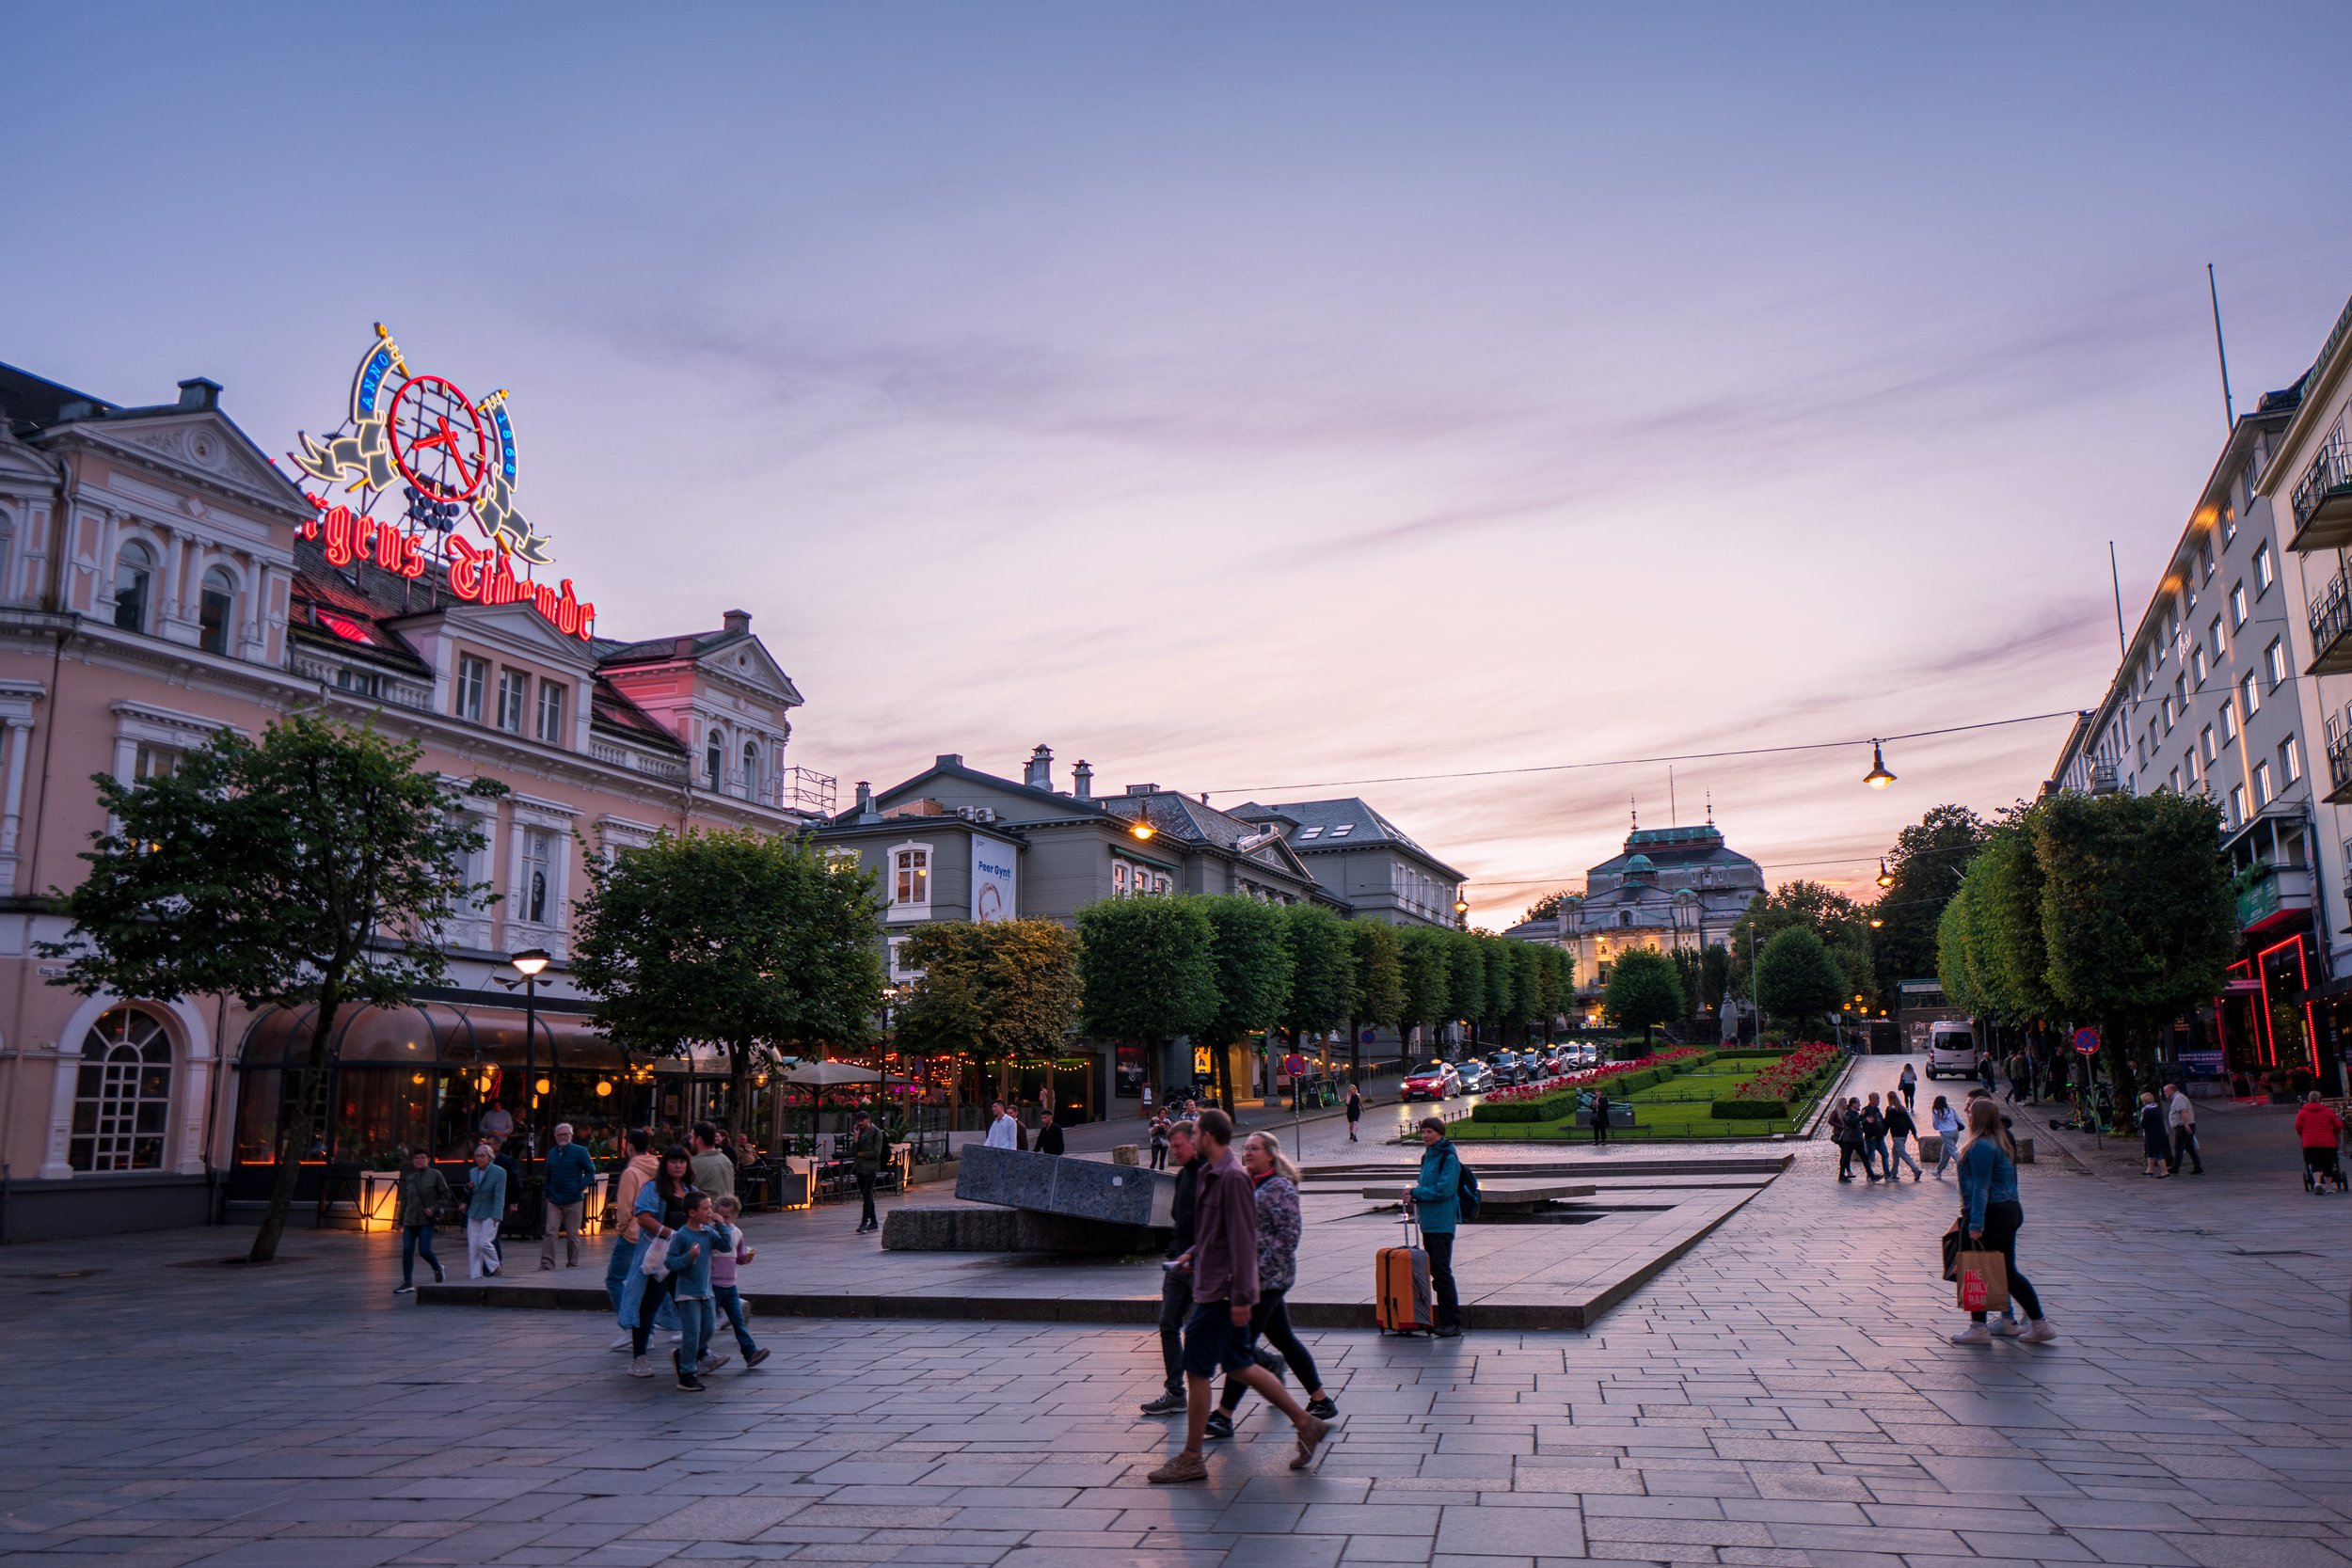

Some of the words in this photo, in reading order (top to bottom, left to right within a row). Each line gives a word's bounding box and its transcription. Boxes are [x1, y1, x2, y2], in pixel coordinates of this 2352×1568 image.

[361, 351, 390, 411] ANNO
[496, 413, 516, 475] 1868
[978, 860, 993, 874] Peer
[994, 865, 1010, 879] Gynt
[1966, 1269, 1982, 1280] THE
[1967, 1281, 1988, 1293] ONLY
[1968, 1294, 1987, 1306] BAG
